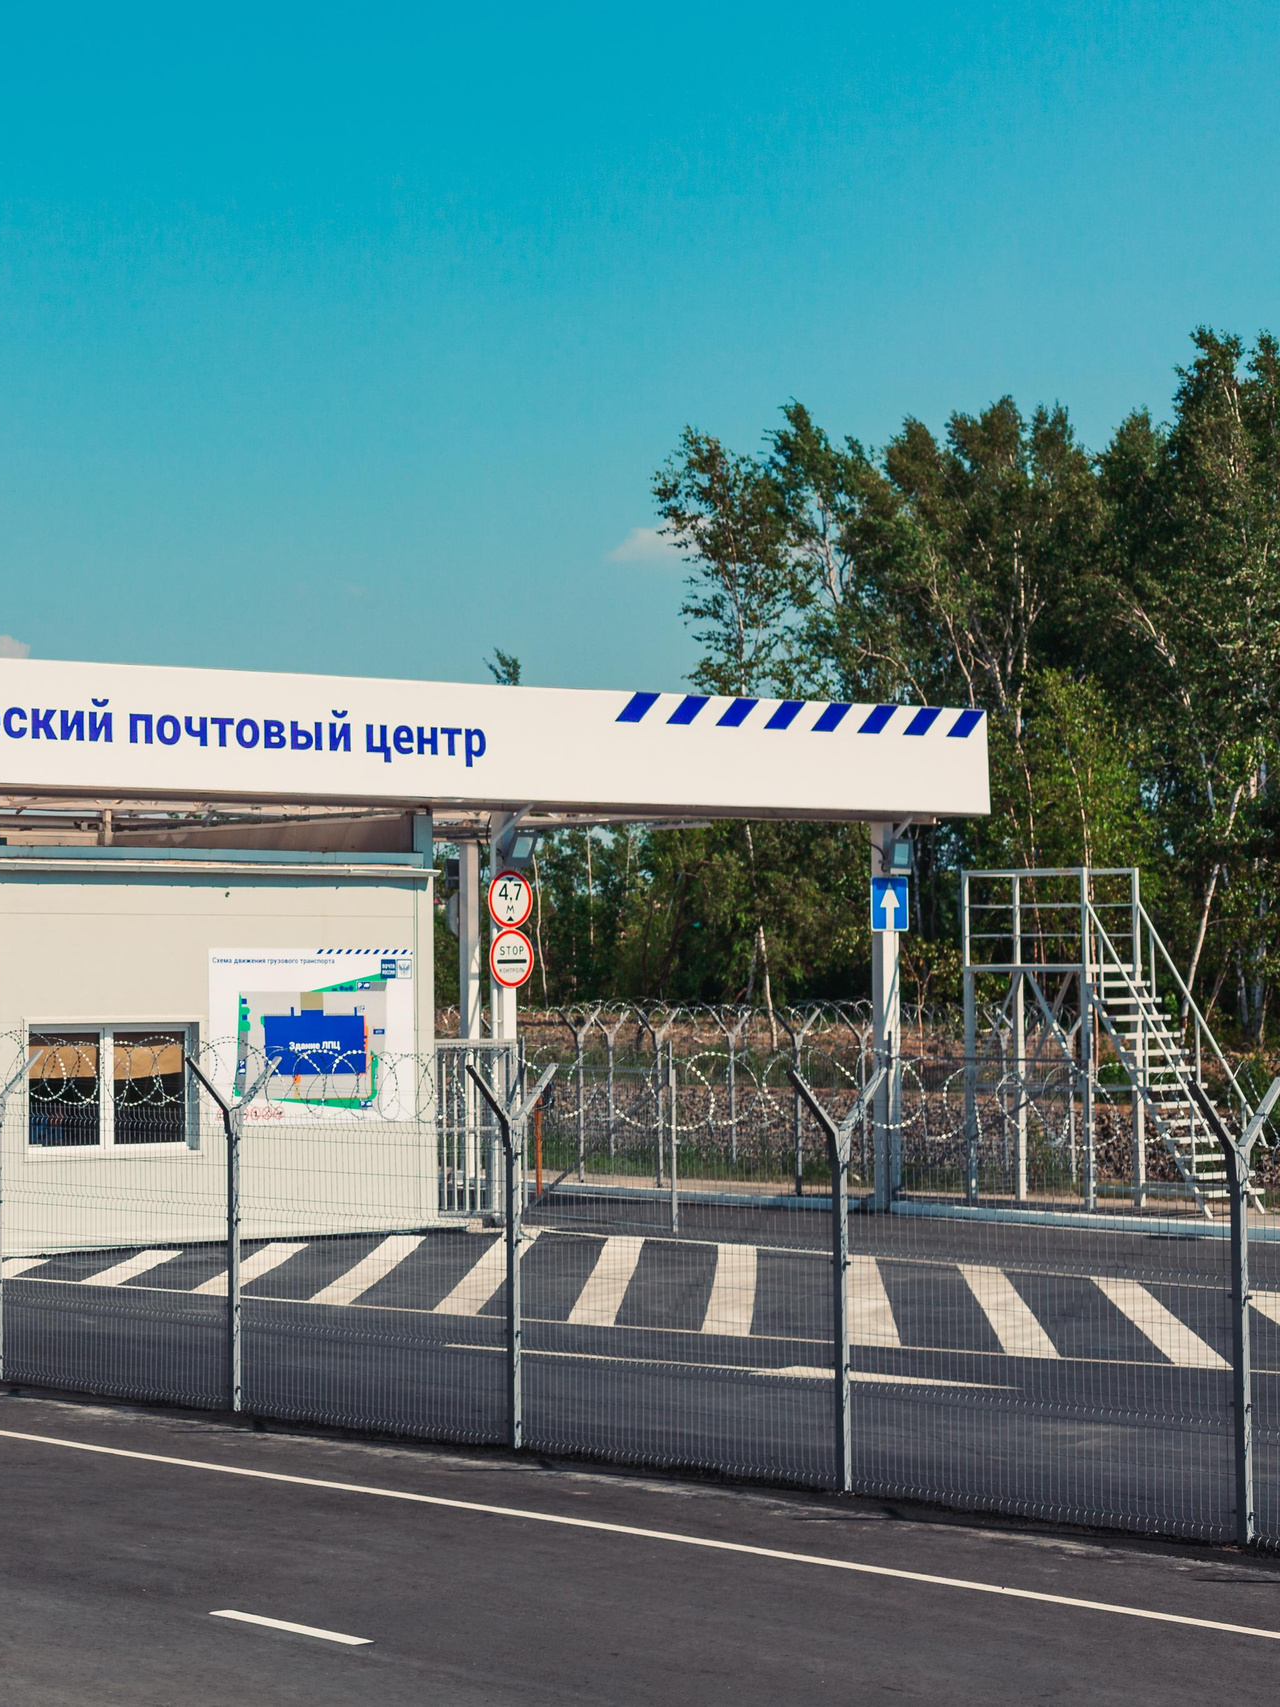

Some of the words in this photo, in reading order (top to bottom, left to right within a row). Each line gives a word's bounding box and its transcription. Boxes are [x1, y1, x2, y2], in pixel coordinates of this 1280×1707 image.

[130, 710, 350, 751] почтовый
[366, 724, 485, 767] центр
[498, 883, 522, 902] 4,7
[500, 946, 524, 956] STOP
[289, 1041, 320, 1051] Здание
[322, 1040, 341, 1051] ЛПЦ
